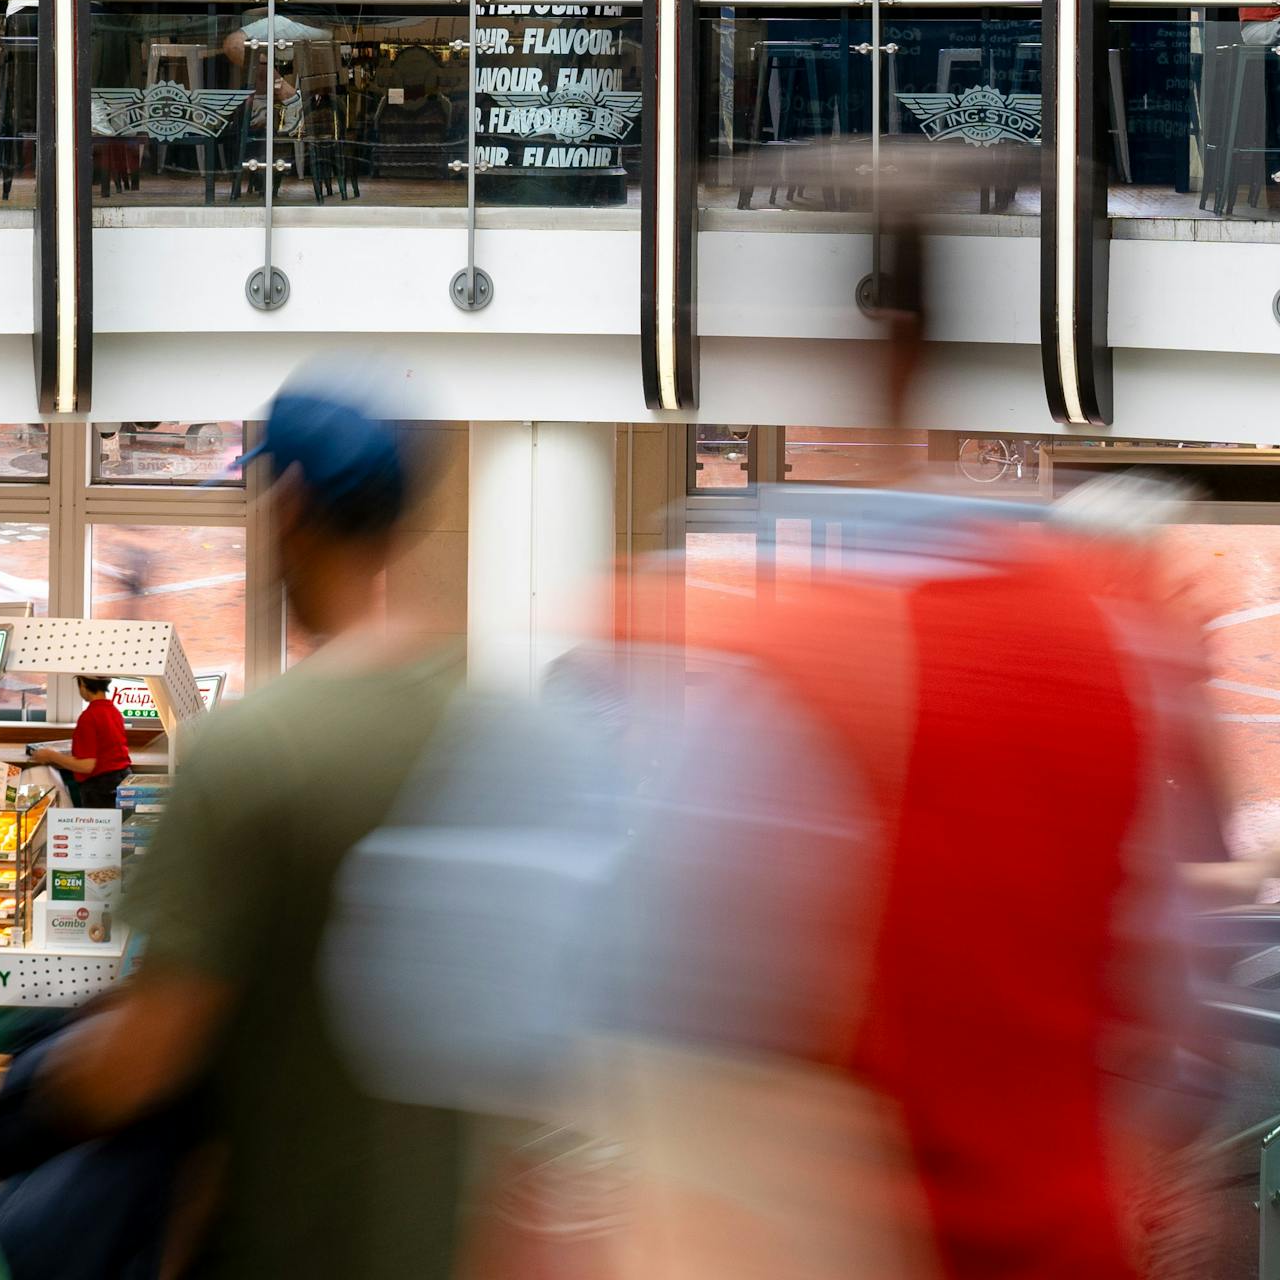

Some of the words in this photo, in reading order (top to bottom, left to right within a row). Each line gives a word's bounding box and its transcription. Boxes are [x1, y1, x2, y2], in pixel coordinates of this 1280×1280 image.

[522, 28, 616, 55] FLAVOUR.
[54, 878, 82, 887] DOZEN
[51, 918, 86, 928] Combo
